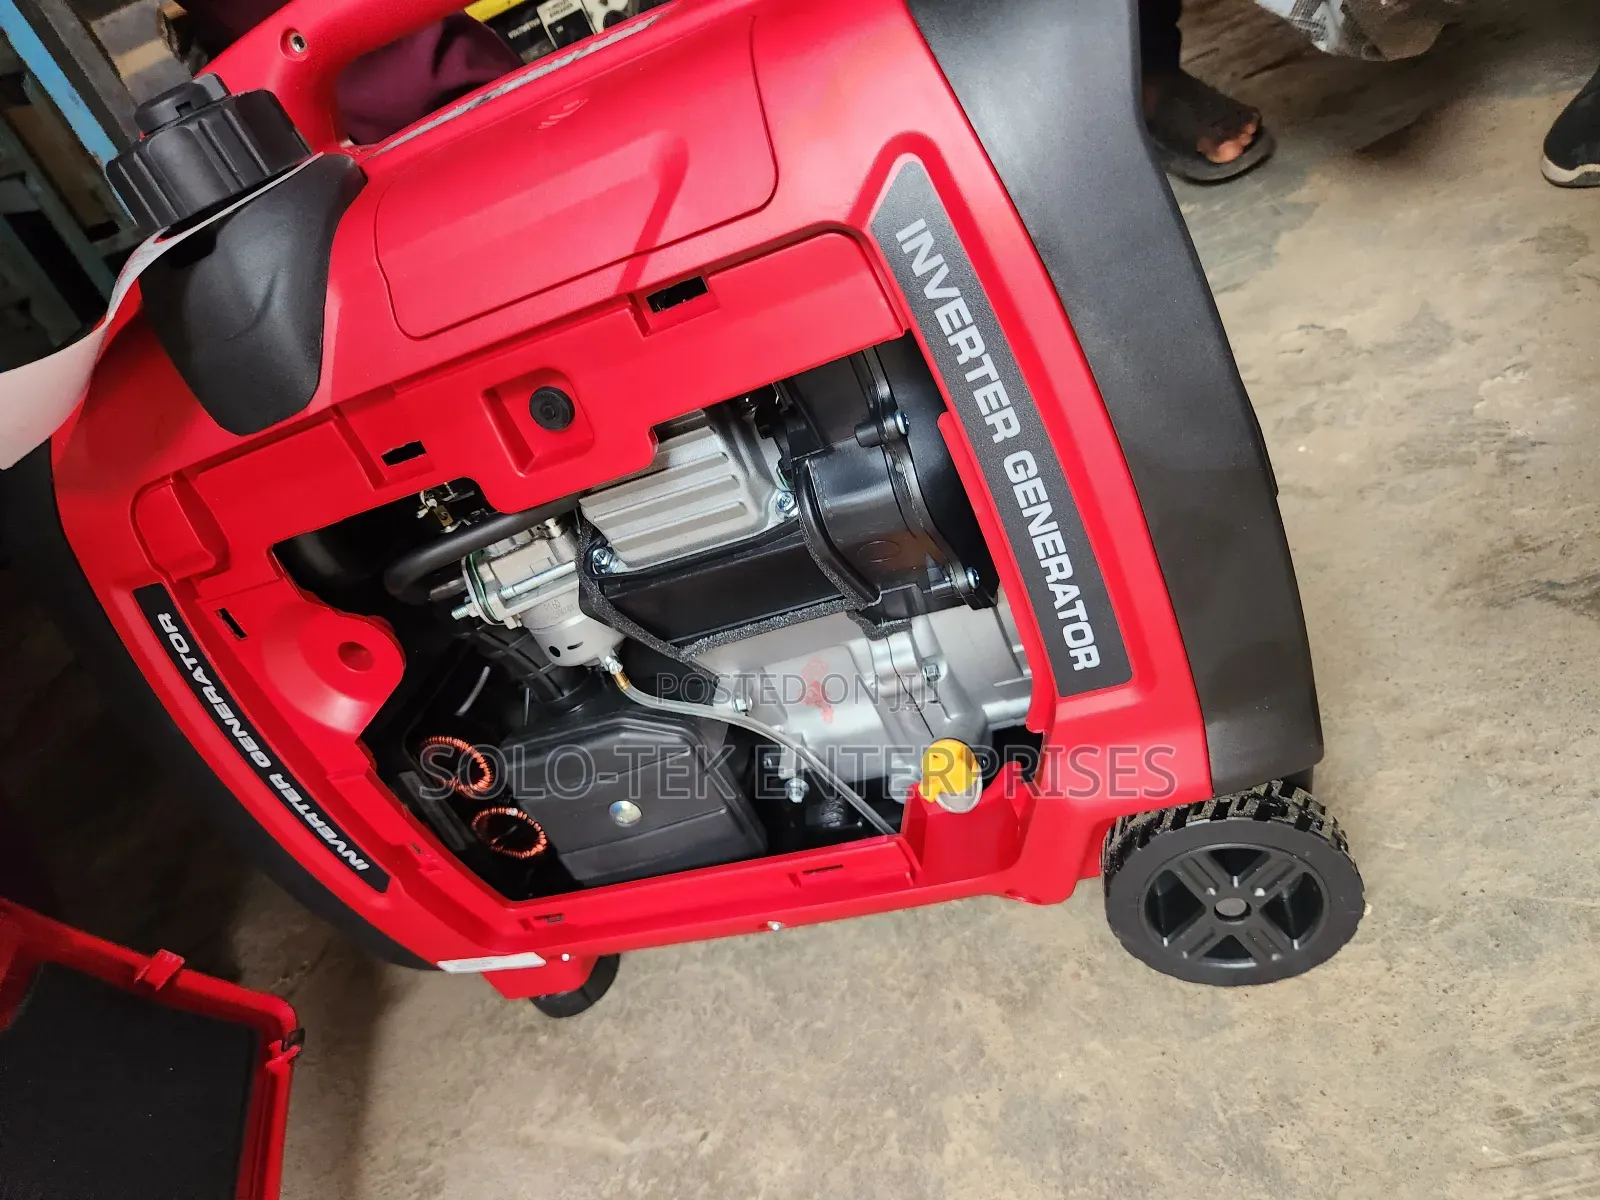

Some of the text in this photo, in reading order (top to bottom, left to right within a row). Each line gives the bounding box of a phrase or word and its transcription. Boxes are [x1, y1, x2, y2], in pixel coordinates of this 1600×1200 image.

[895, 217, 1100, 671] INVERTER GENERATOR
[157, 612, 370, 871] INVERTER GENERATOR
